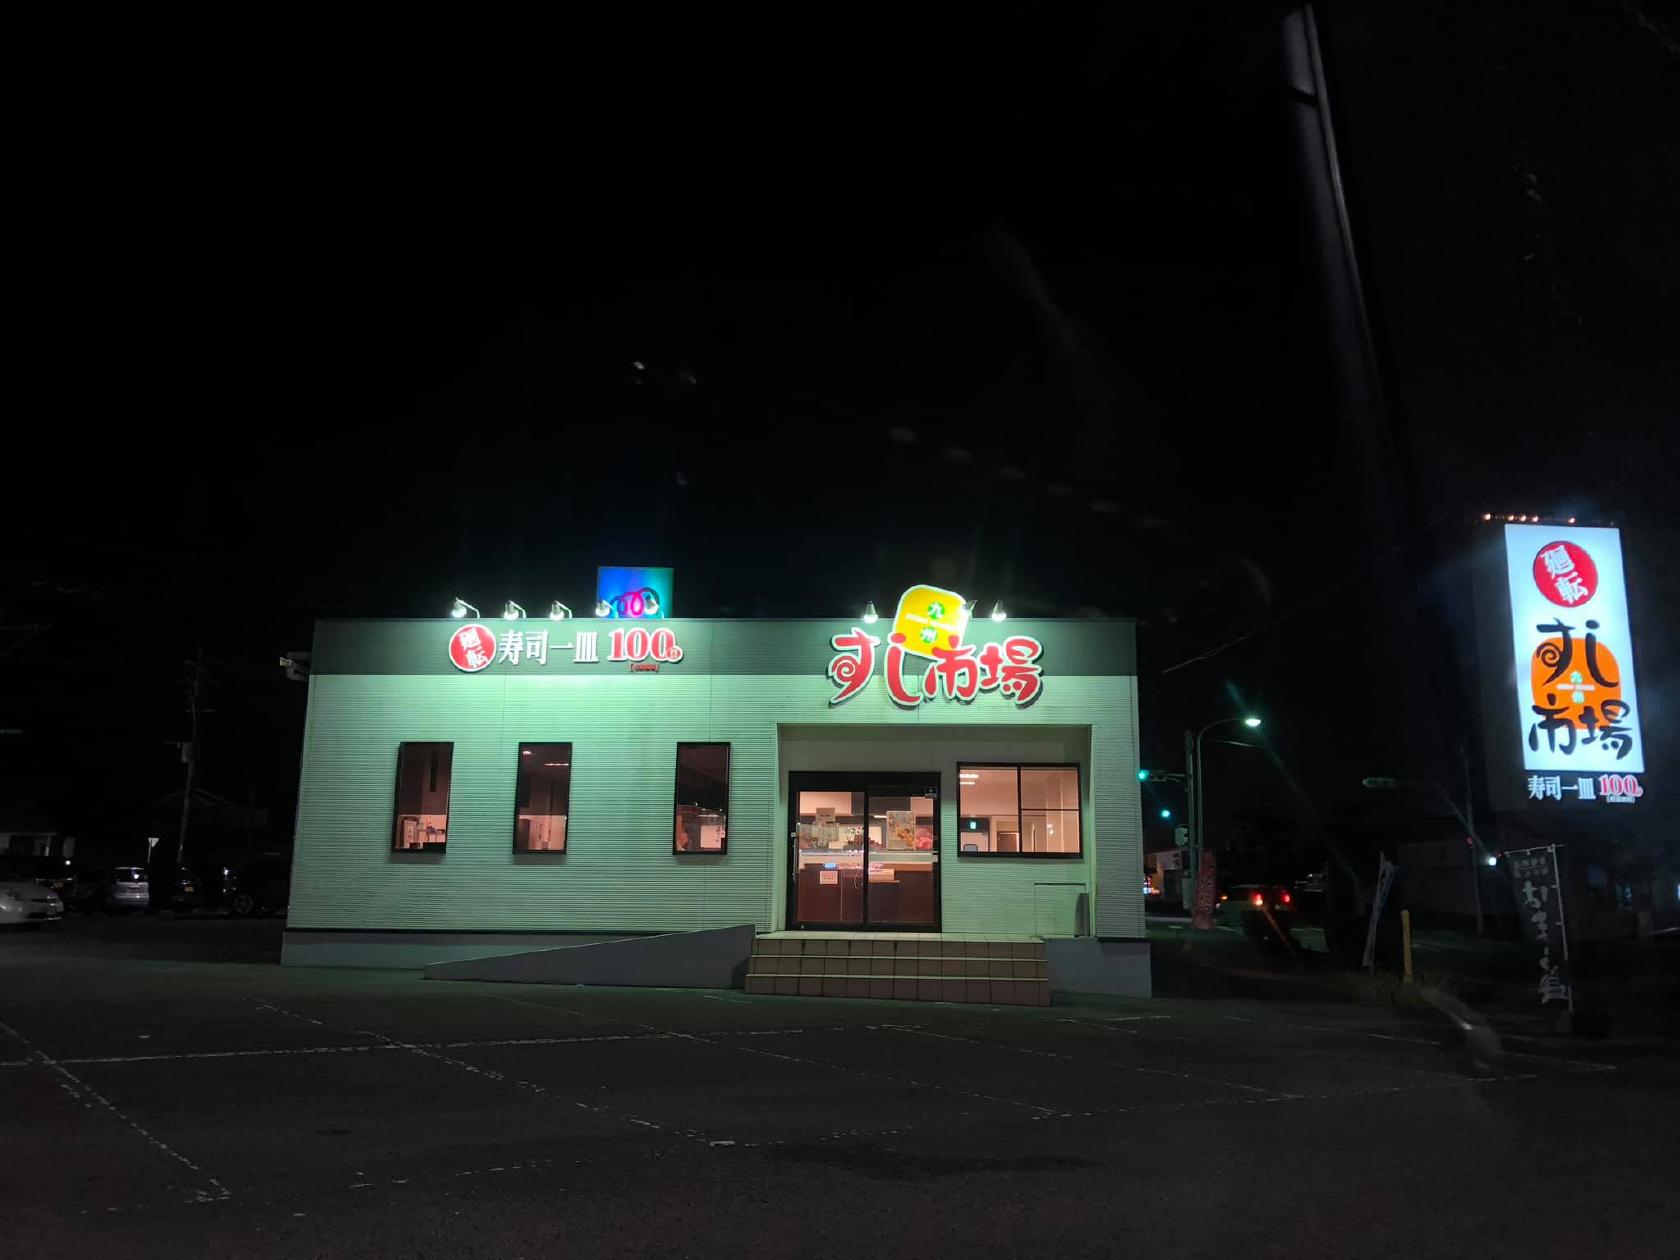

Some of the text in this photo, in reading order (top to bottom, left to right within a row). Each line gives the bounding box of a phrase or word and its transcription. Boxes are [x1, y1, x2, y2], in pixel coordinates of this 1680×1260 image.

[1541, 545, 1589, 605] 廻転
[499, 629, 599, 665] 寿司一皿
[830, 628, 1044, 708] すし市場
[1534, 617, 1620, 688] すし
[1529, 693, 1633, 761] 市場
[1528, 773, 1643, 801] 寿司一皿 100
